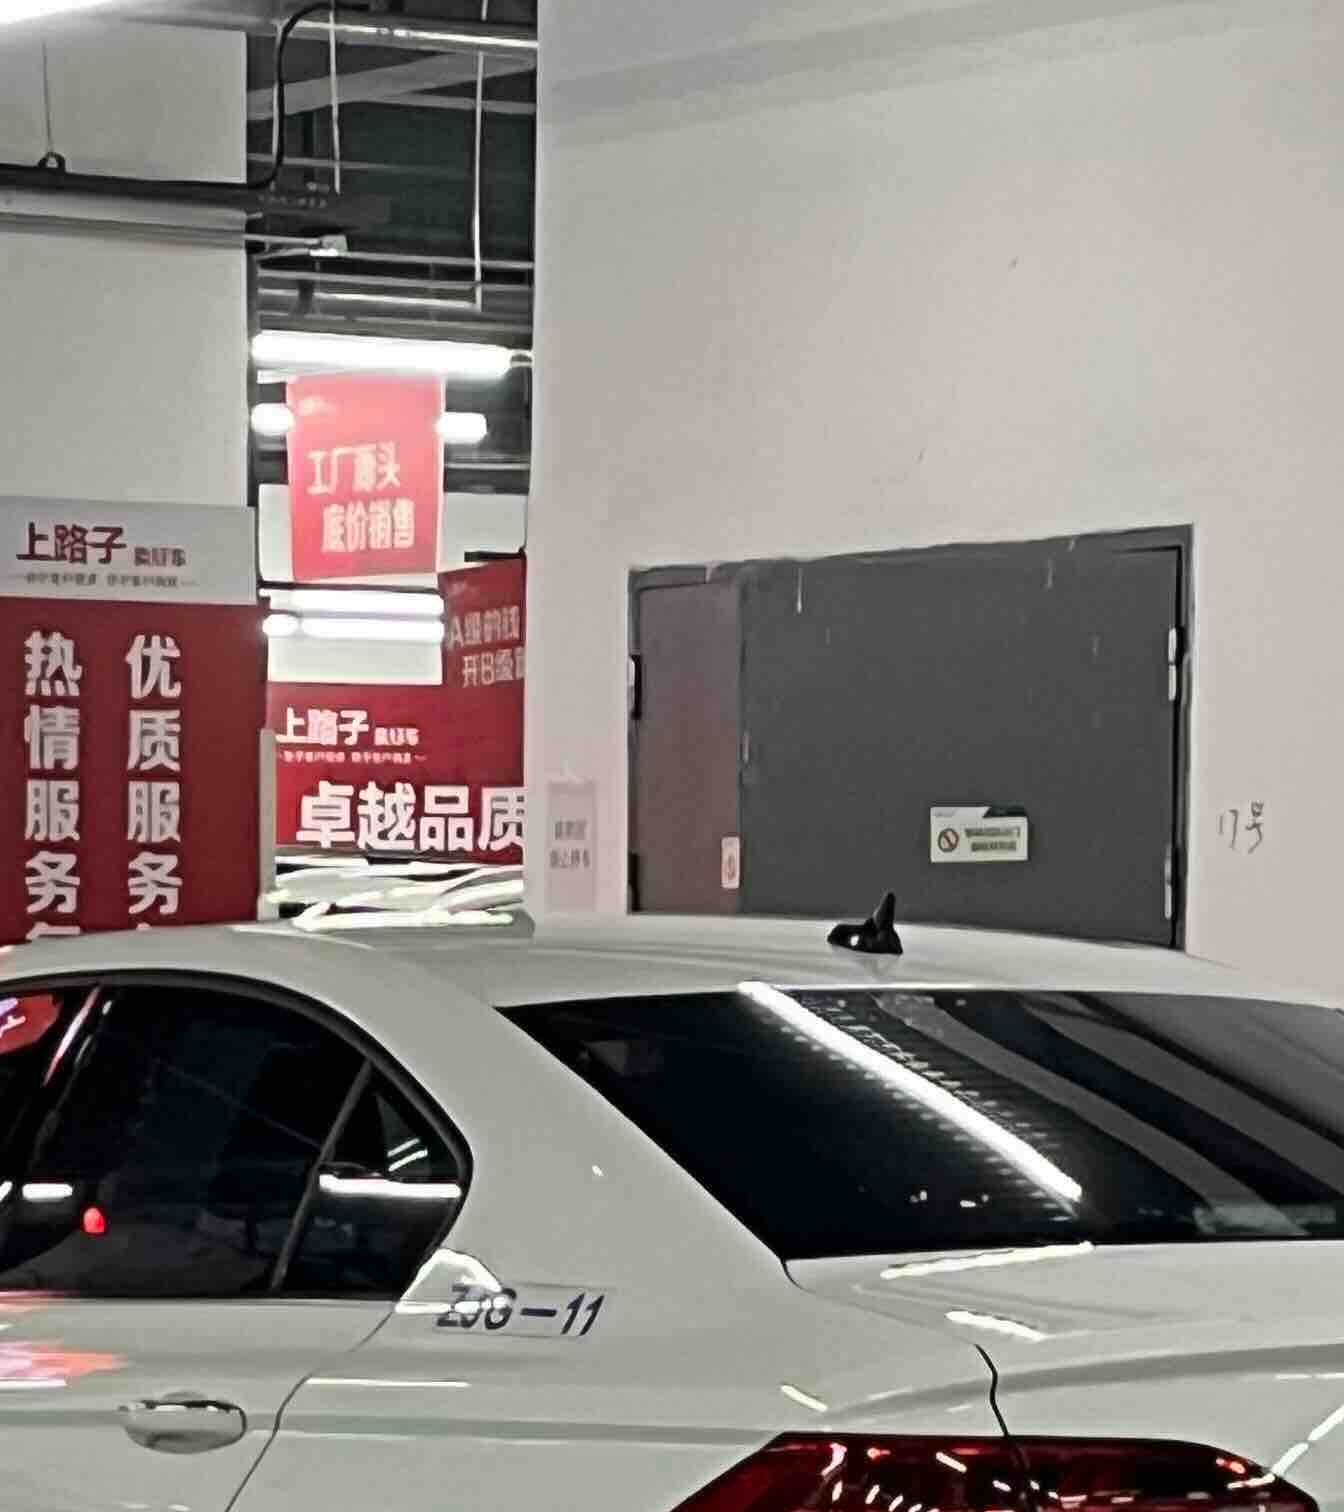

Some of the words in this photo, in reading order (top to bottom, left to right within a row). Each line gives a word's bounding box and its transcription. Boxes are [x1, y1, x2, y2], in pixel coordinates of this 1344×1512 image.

[16, 521, 127, 565] 上路子
[275, 707, 370, 746] 上路子
[24, 630, 82, 939] 热情服务
[297, 780, 525, 853] 卓越品质
